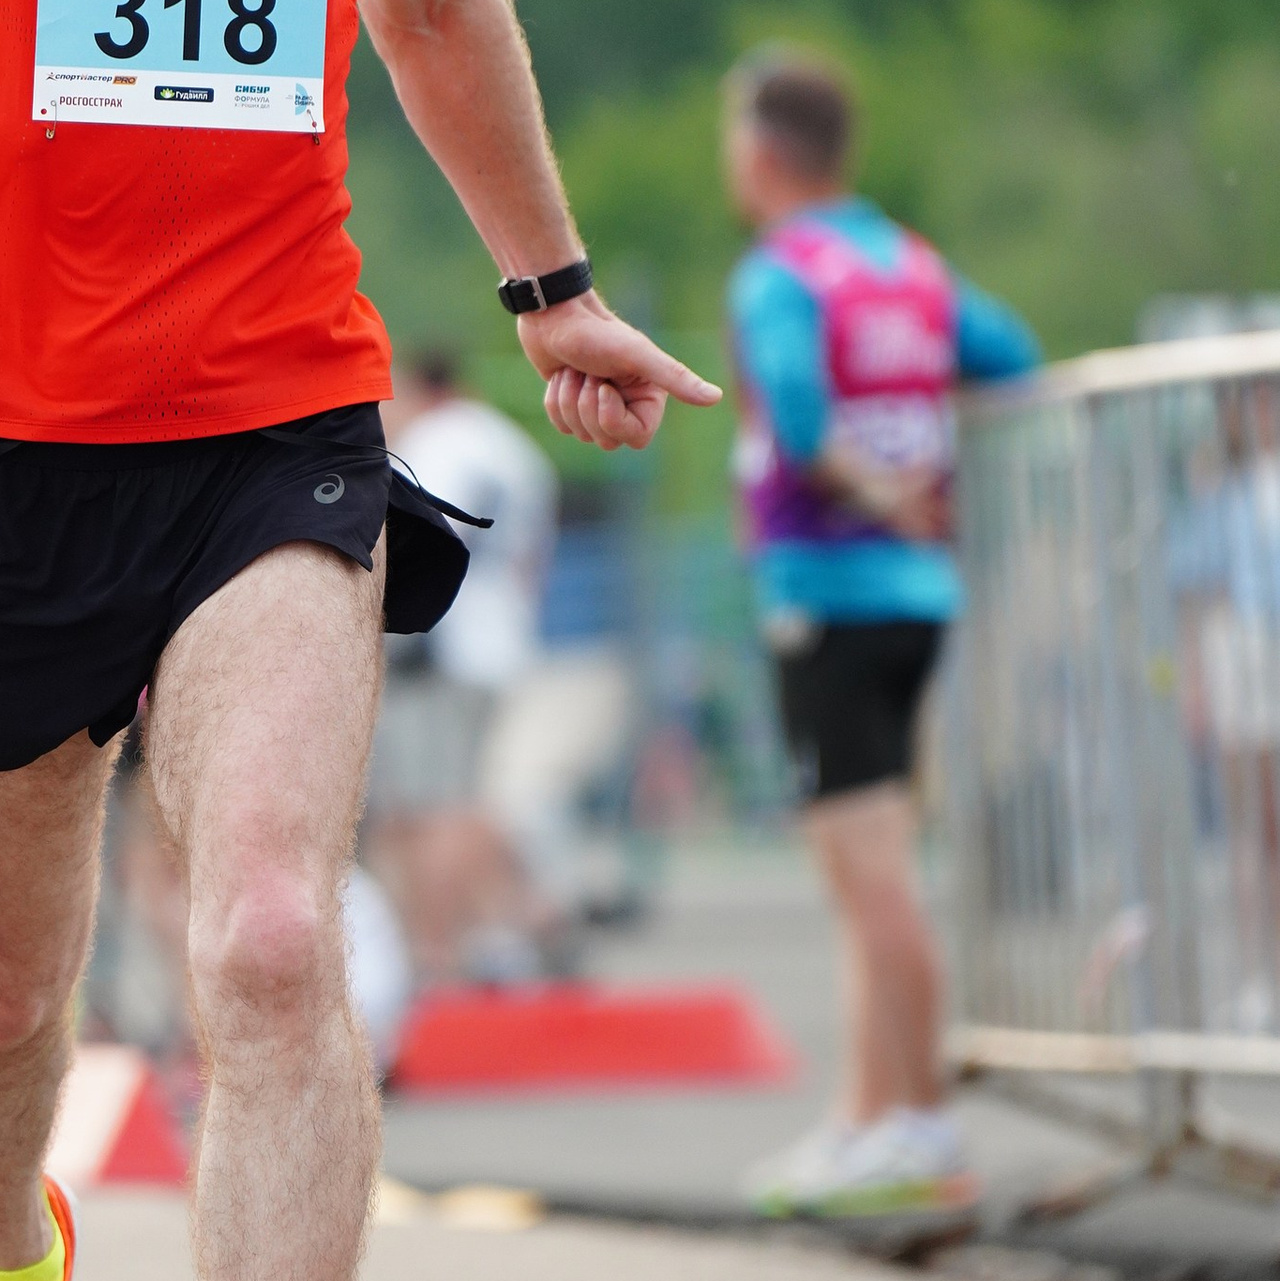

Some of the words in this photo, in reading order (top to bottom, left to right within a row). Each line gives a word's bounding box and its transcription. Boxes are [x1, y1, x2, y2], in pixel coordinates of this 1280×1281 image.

[113, 75, 137, 85] PRO
[235, 85, 270, 94] СИБУР
[59, 95, 123, 108] РОСГОССТРАХ
[234, 95, 270, 104] ФОРМУЛА
